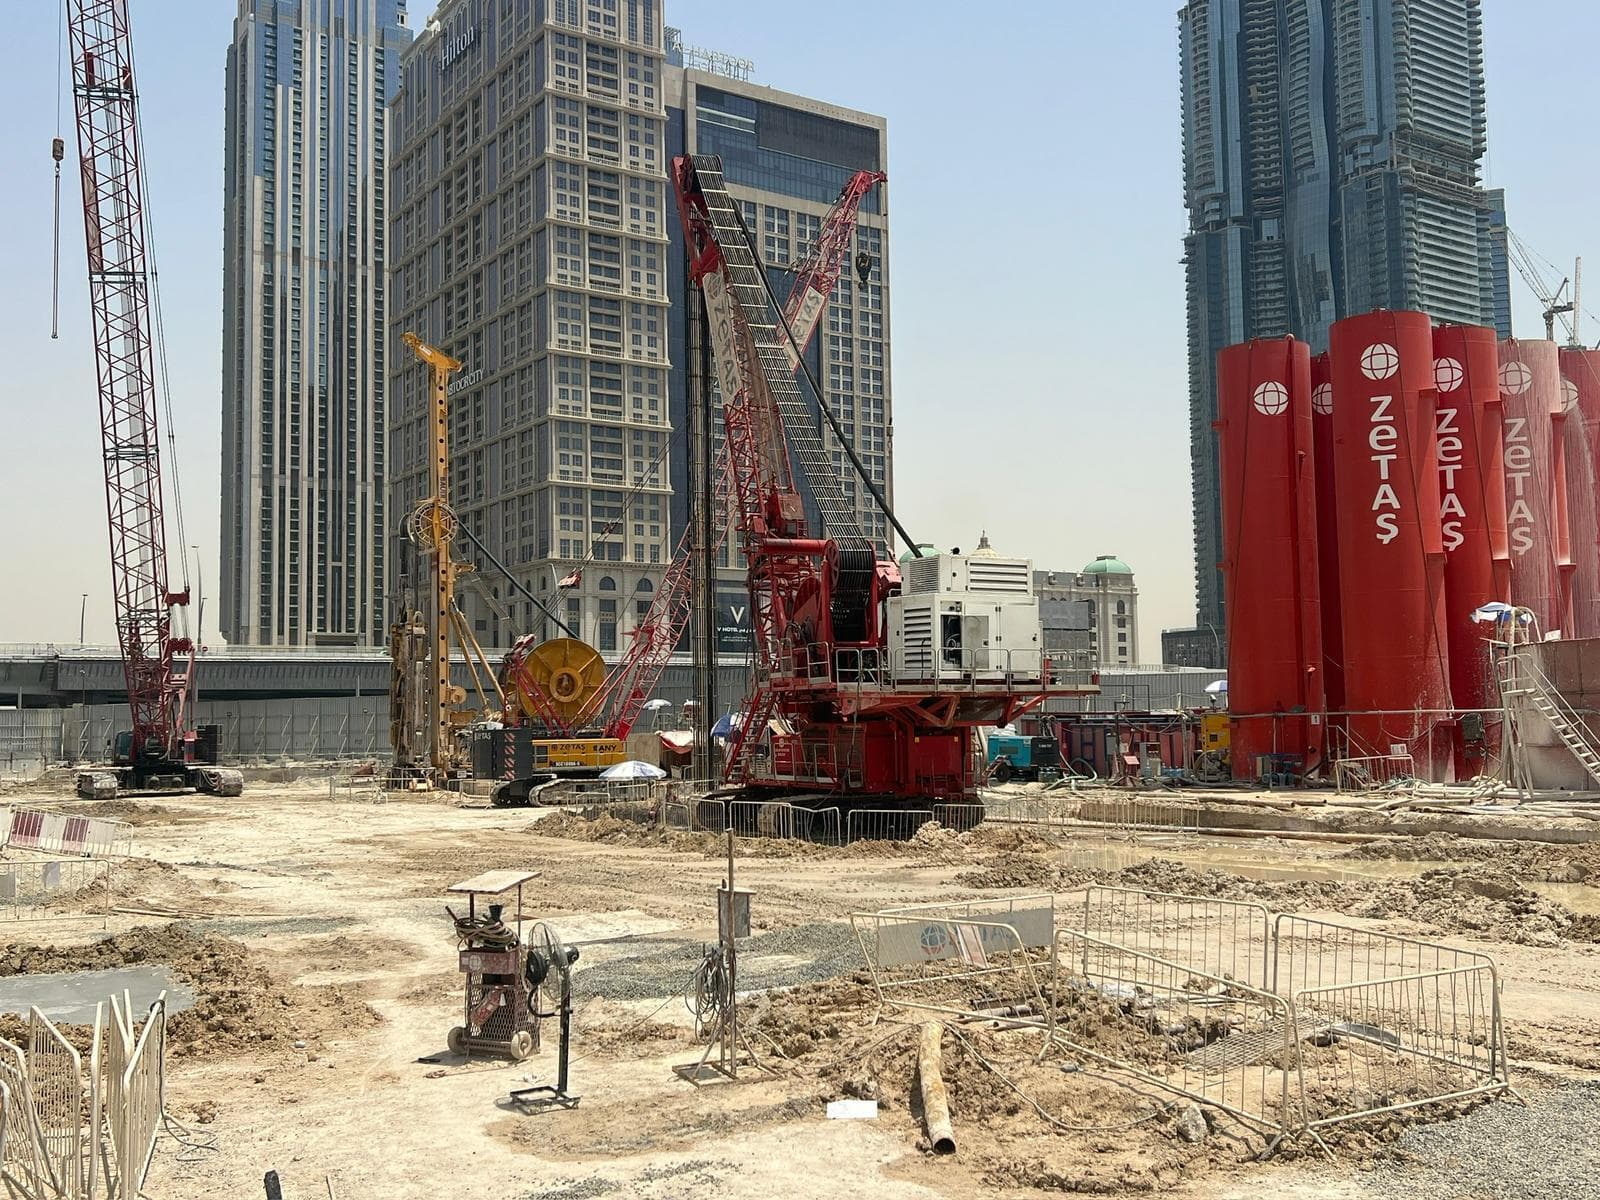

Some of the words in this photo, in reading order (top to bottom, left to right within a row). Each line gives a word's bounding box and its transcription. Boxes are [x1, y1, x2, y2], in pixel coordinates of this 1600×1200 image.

[441, 26, 474, 70] Hilton
[730, 606, 745, 624] V
[592, 744, 617, 752] SANY
